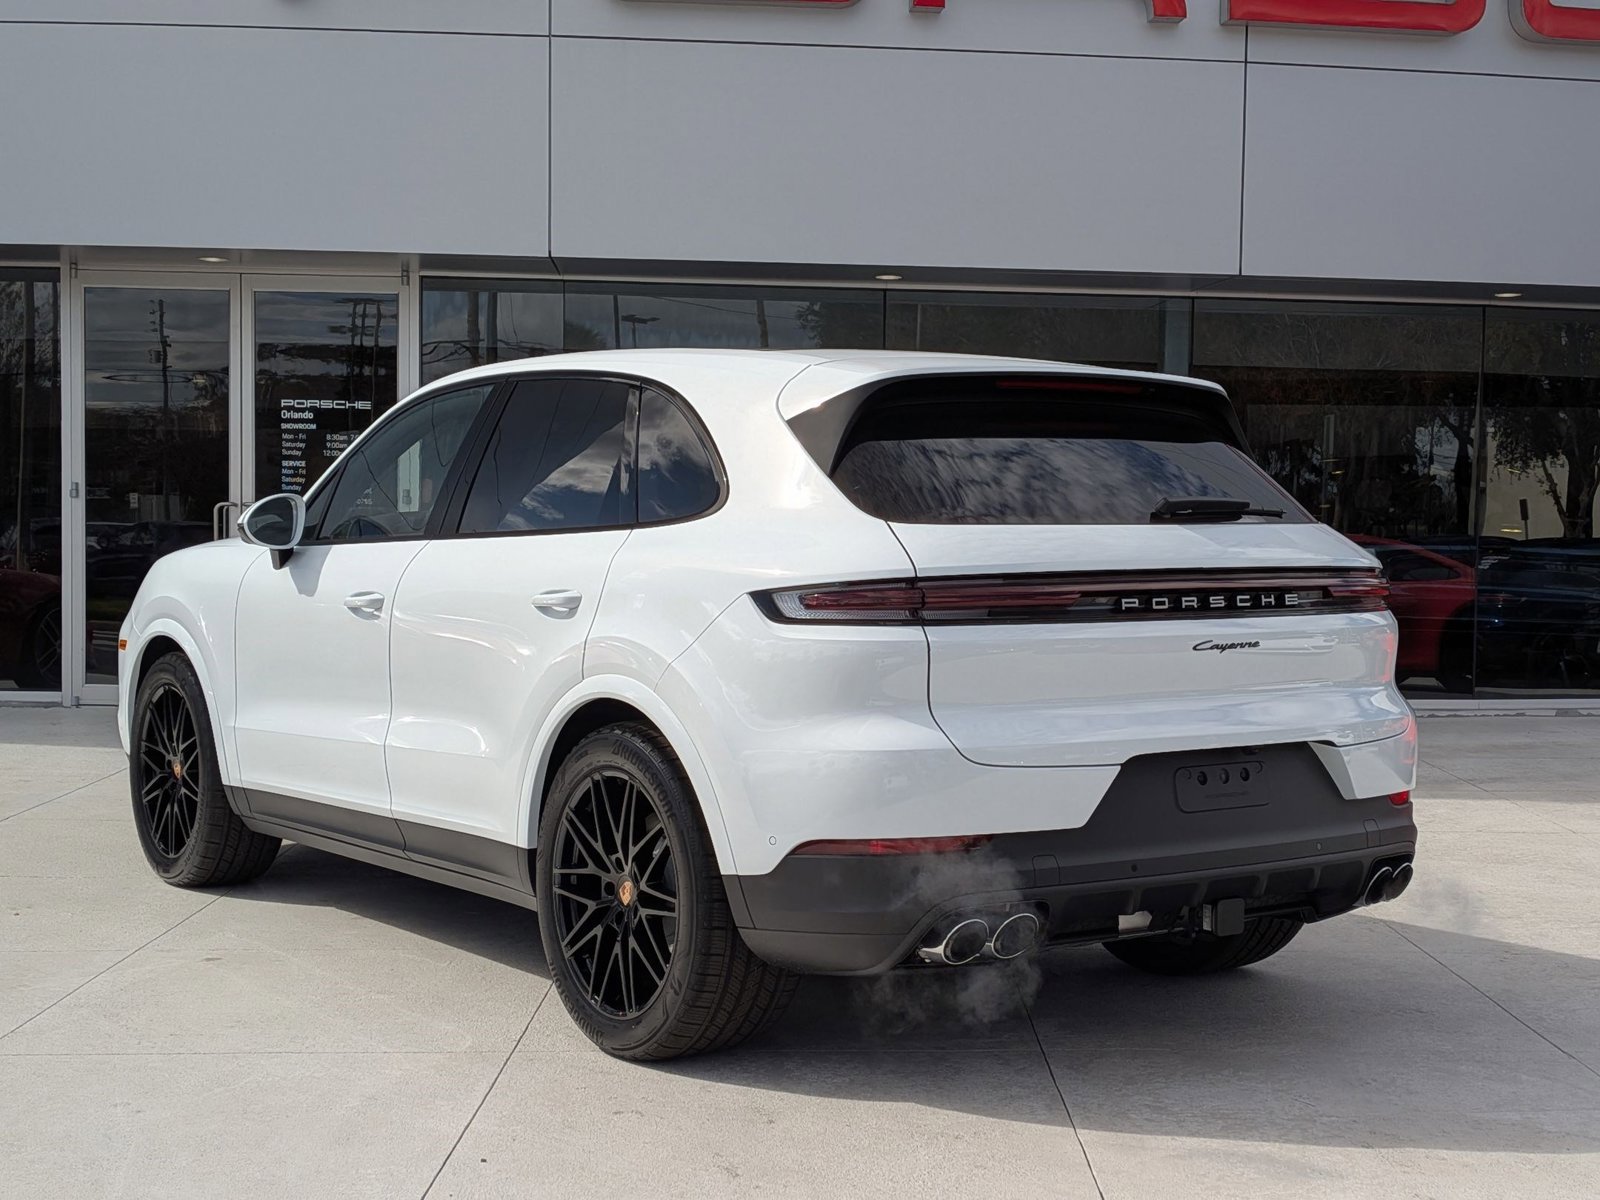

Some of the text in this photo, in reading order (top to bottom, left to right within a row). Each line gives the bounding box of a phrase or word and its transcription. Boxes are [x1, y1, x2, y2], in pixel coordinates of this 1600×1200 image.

[280, 399, 372, 409] PORSCHE
[281, 410, 314, 419] Orlando
[281, 422, 317, 430] SHOWROOM
[281, 441, 306, 449] Saturday
[281, 449, 302, 457] Sunday
[281, 475, 306, 484] Saturday
[281, 484, 302, 492] Sunday
[1121, 593, 1299, 611] PORSCHE
[1192, 639, 1260, 654] Cayenne
